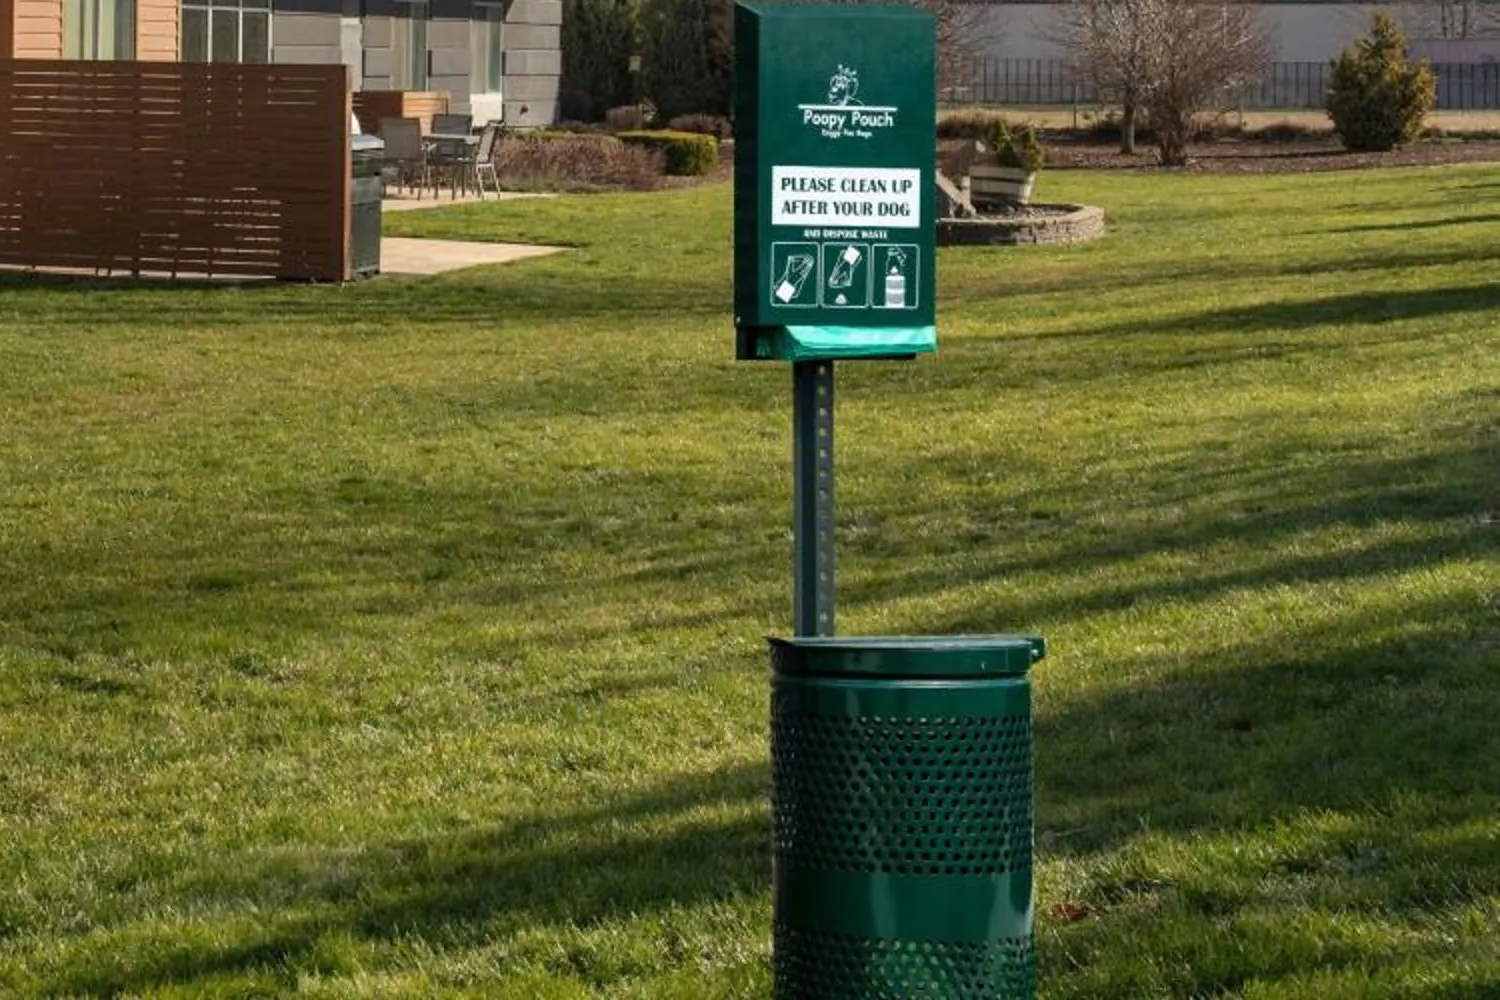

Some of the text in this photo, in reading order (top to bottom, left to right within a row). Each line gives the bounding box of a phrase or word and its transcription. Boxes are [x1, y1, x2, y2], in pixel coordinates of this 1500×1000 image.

[804, 110, 894, 129] Poopy Pouch
[781, 177, 912, 193] PLEASE CLEAN UP
[782, 200, 911, 216] AFTER YOUR DOG
[804, 229, 888, 239] AND DISPOSE WASTE
